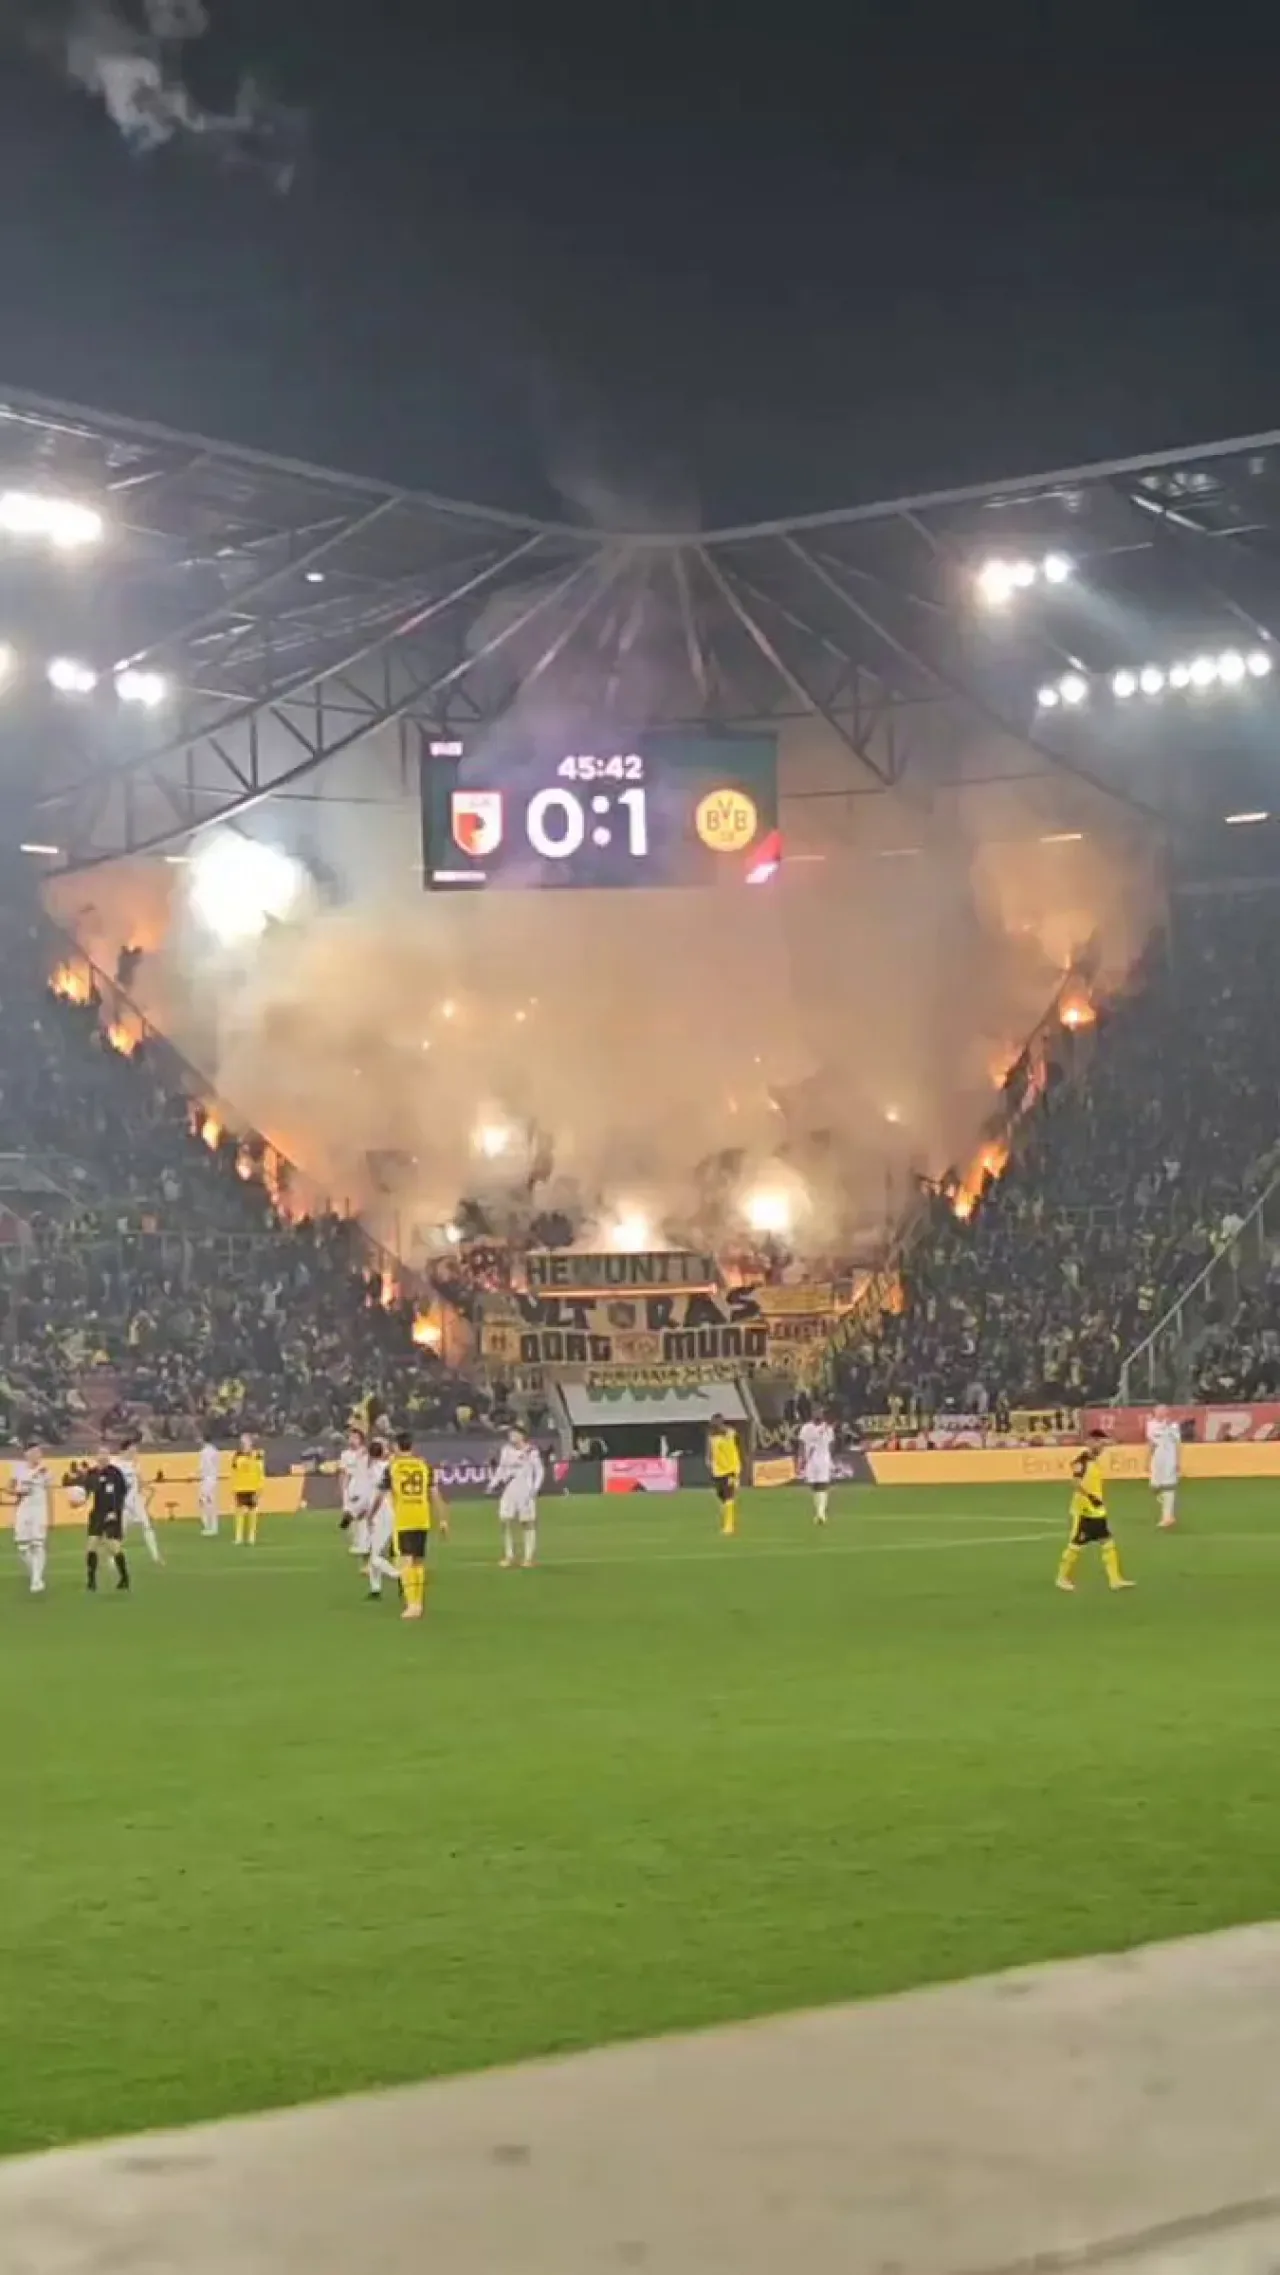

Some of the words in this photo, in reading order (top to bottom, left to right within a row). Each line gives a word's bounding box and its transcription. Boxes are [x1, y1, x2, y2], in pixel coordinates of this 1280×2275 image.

[557, 755, 643, 780] 45:42
[526, 788, 649, 858] 0:1
[707, 797, 748, 831] BVB
